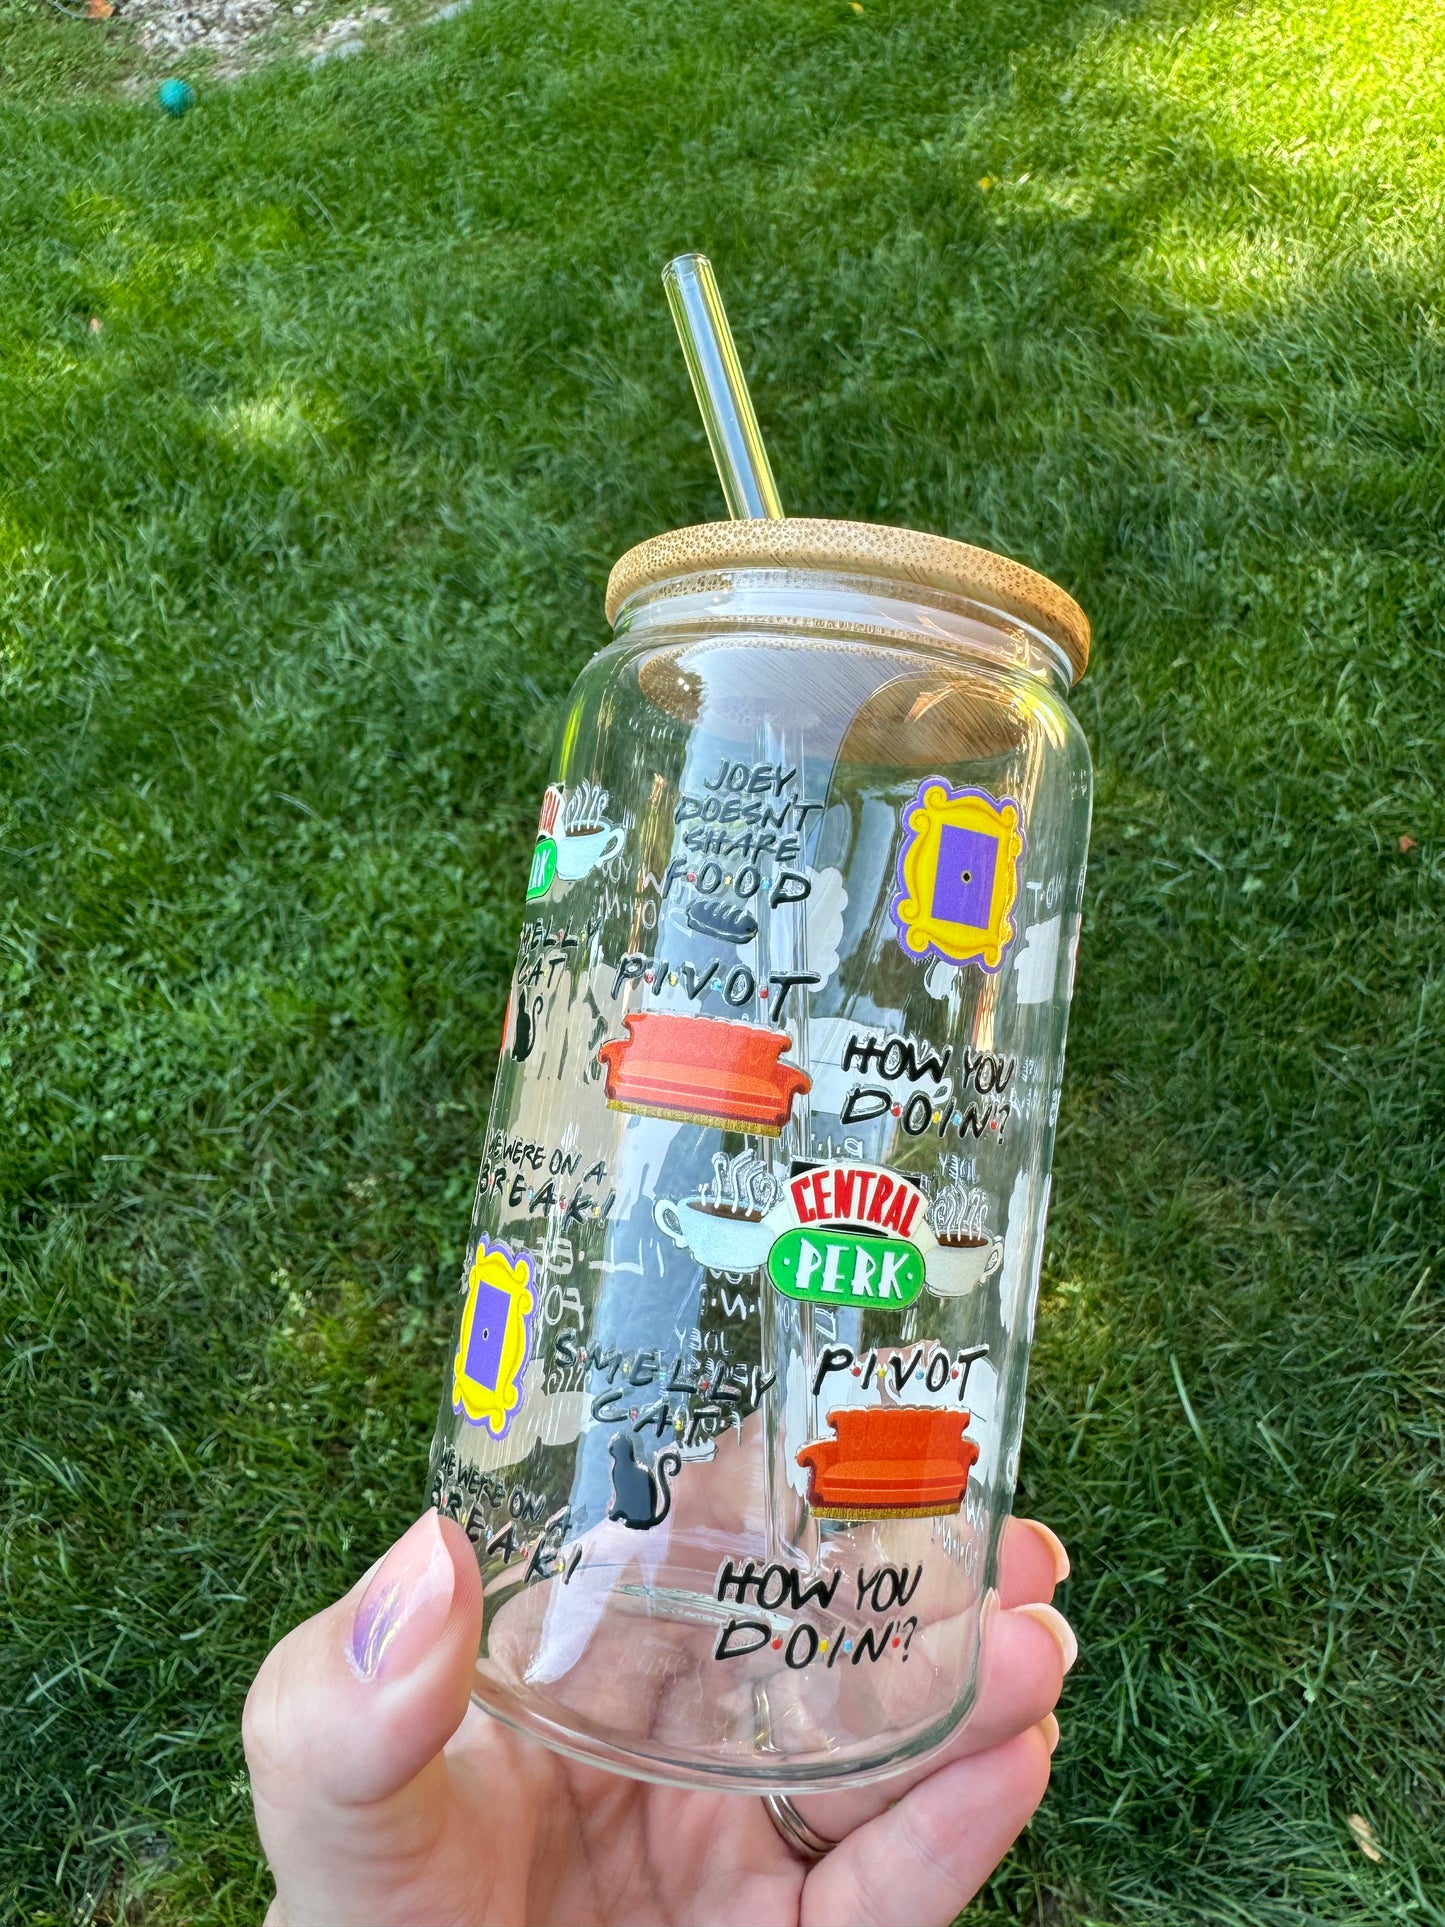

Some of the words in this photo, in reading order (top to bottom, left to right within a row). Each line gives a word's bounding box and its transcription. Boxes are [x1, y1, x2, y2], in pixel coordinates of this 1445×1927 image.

[703, 759, 797, 797] JOEY
[683, 826, 801, 864] SHARE
[660, 854, 812, 909] FOOD
[518, 952, 568, 988] CAT
[610, 955, 821, 1023] PIVOT
[841, 1034, 953, 1084] HOW
[962, 1046, 1015, 1094] YOU
[503, 1134, 546, 1171] WERE
[549, 1148, 582, 1176] ON
[583, 1159, 607, 1186] A
[790, 1169, 920, 1238] CENTRAL
[795, 1238, 910, 1299] PERK
[554, 1327, 777, 1408] SMELLY
[812, 1346, 990, 1402] PIVOT
[590, 1387, 722, 1447] CAT
[508, 1484, 547, 1522] ON
[544, 1505, 573, 1538] A
[717, 1561, 842, 1610] HOW
[856, 1563, 923, 1612] YOU
